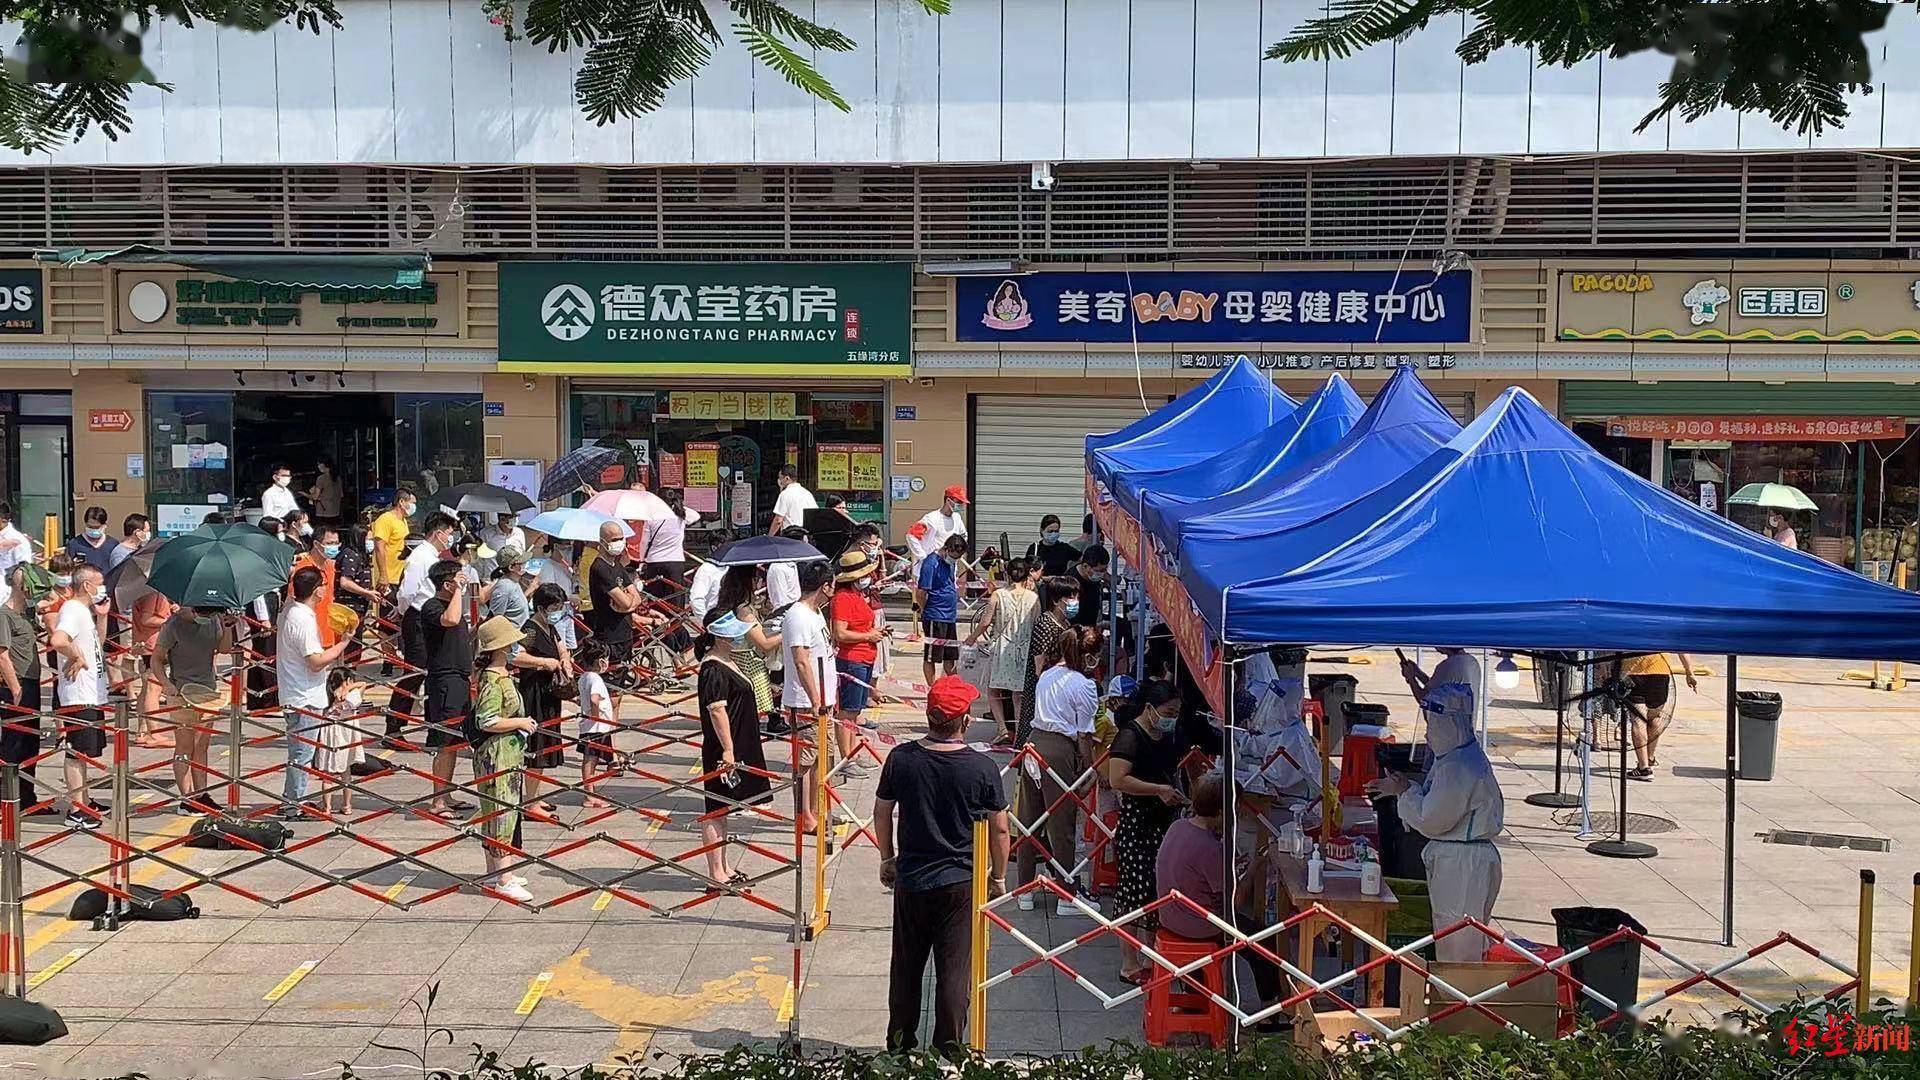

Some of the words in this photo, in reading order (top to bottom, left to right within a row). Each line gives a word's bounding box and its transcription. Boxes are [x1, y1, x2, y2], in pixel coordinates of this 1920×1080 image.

[1573, 274, 1654, 292] PAGODA
[600, 285, 838, 322] 德众堂药房
[1131, 290, 1219, 325] BABY
[1742, 291, 1825, 314] 百果园
[606, 326, 740, 341] DEZHONGTANG
[747, 326, 838, 342] PHARMACY
[846, 311, 859, 341] 连锁
[846, 350, 900, 362] 五缘湾分店
[1181, 354, 1236, 368] 婴幼儿游
[1257, 354, 1313, 368] 小儿推拿
[1320, 354, 1376, 368] 产后修复
[671, 396, 793, 416] 积分当钱花
